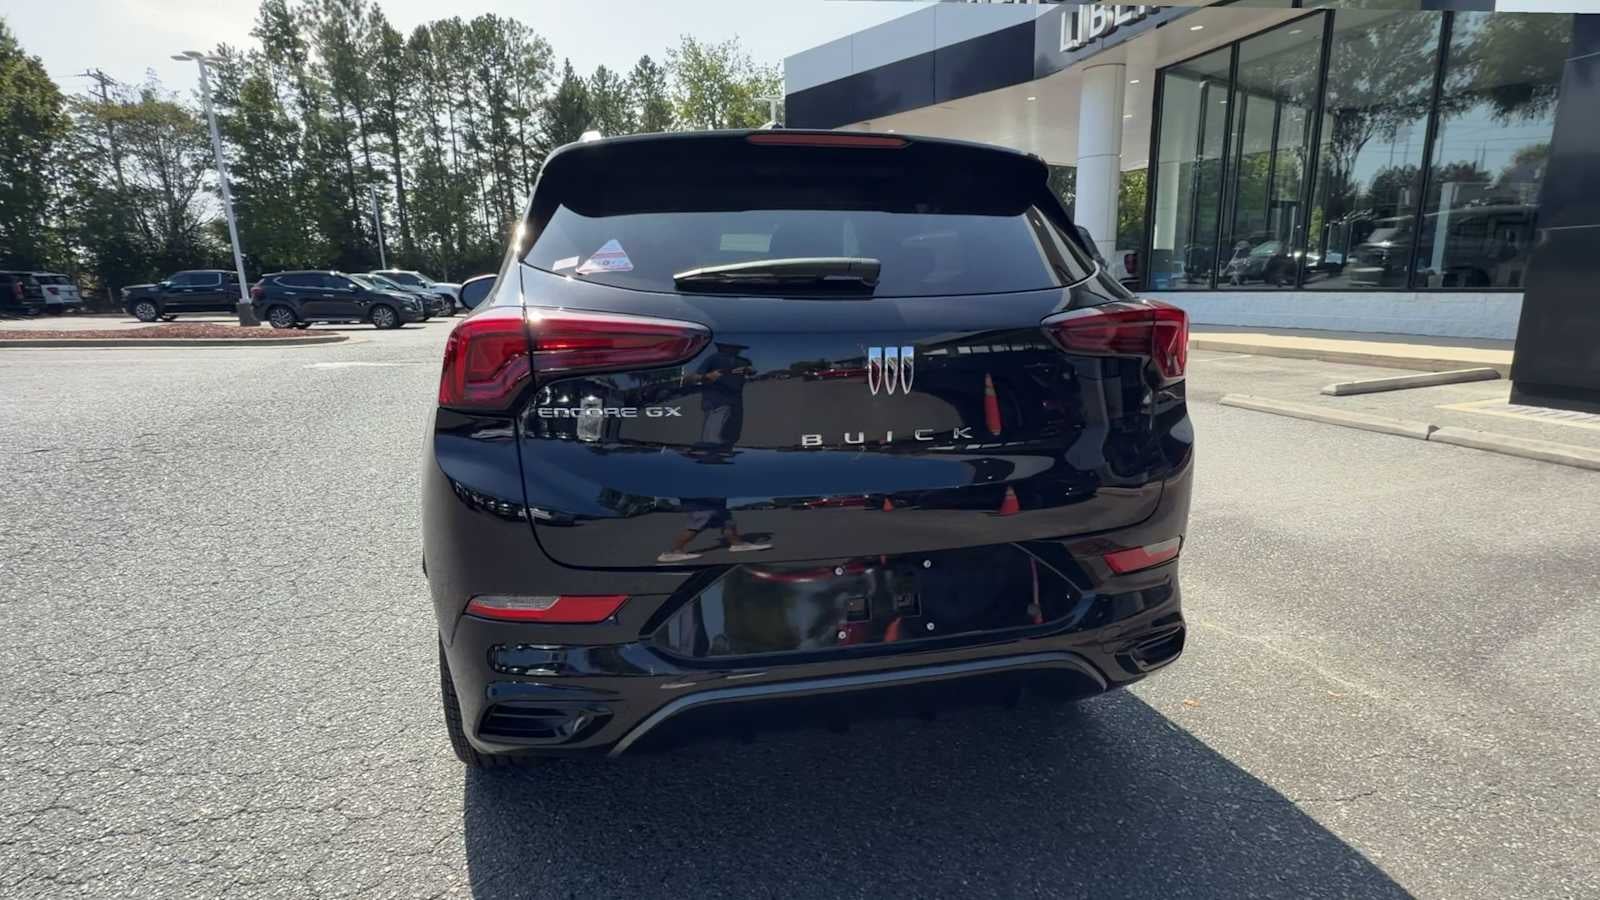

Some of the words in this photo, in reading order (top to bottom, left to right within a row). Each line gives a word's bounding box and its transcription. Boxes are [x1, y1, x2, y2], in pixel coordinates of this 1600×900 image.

[1059, 4, 1158, 52] LIB
[538, 407, 638, 418] ENCORE
[646, 406, 682, 417] GX
[802, 427, 973, 447] BUICK
